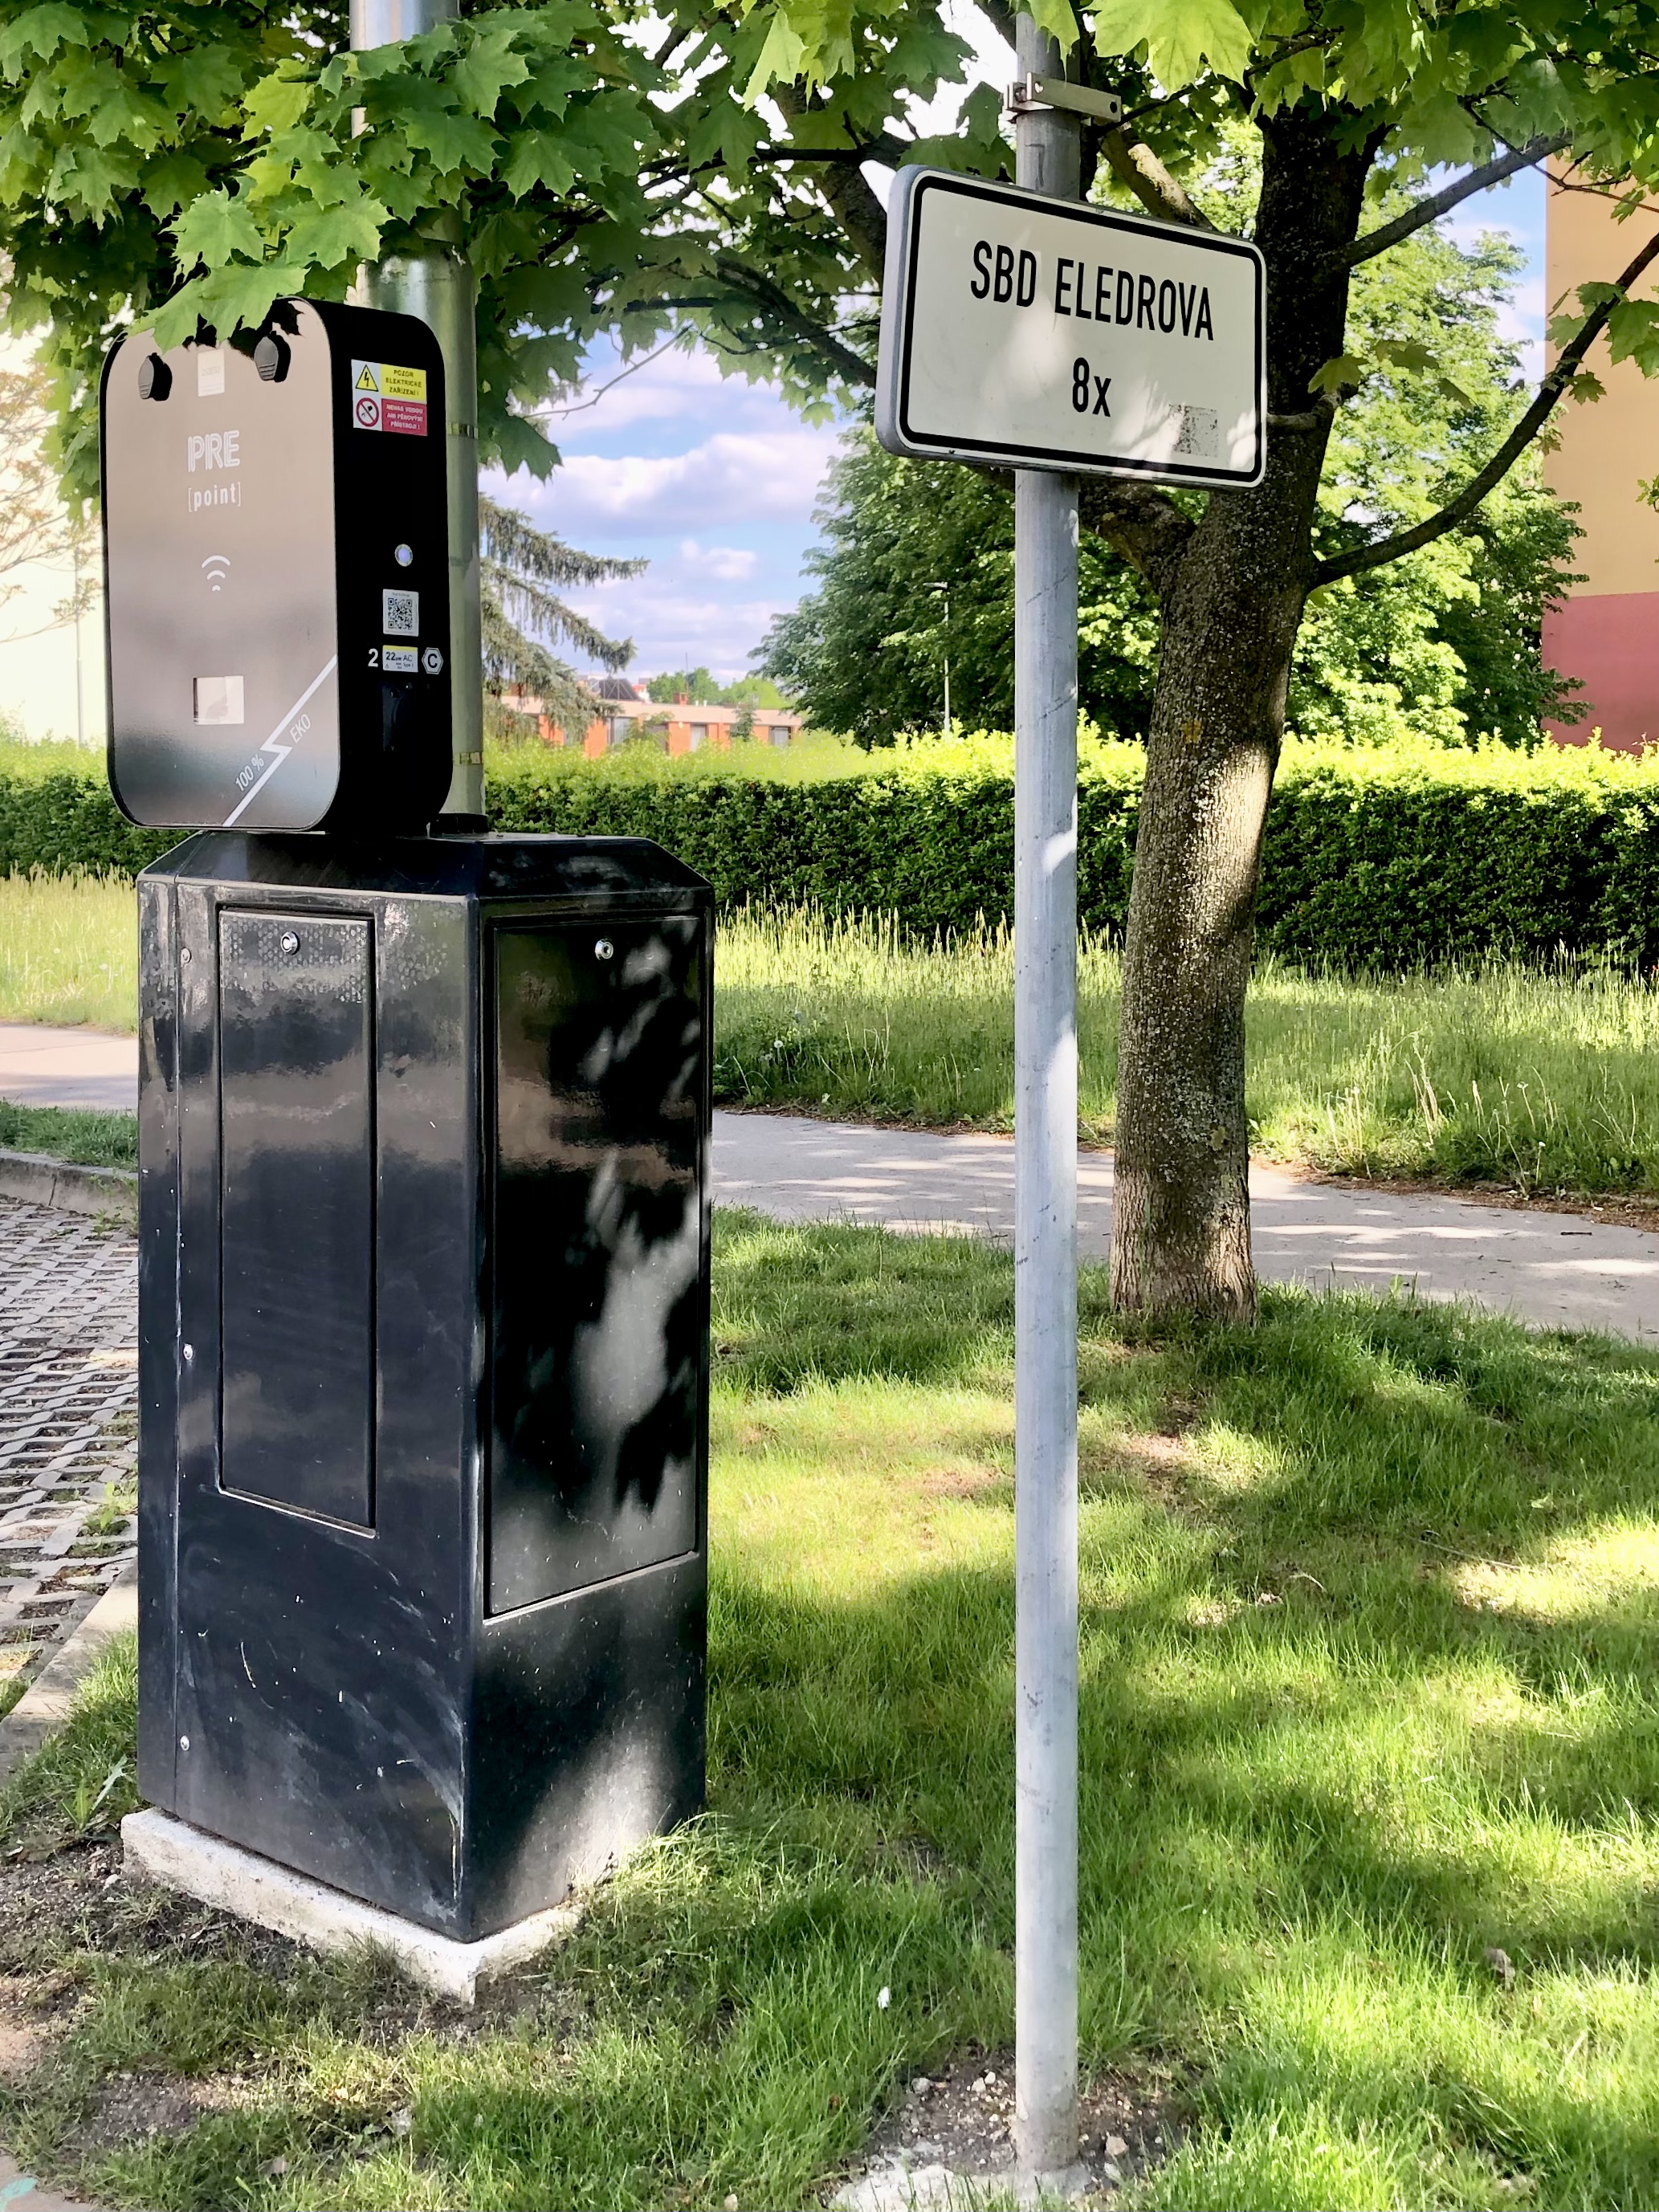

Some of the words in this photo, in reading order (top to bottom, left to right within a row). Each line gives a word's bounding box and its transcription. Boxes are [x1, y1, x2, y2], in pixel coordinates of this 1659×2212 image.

[970, 241, 1038, 307] SBD
[1055, 258, 1214, 340] ELEDROVA
[393, 369, 414, 377] POZOR
[1072, 357, 1111, 418] 8x
[187, 430, 240, 472] PRE
[368, 648, 379, 667] 2
[403, 654, 413, 662] AC
[427, 653, 438, 669] C
[235, 765, 255, 792] 100
[251, 753, 265, 772] %
[290, 713, 312, 743] EKO
